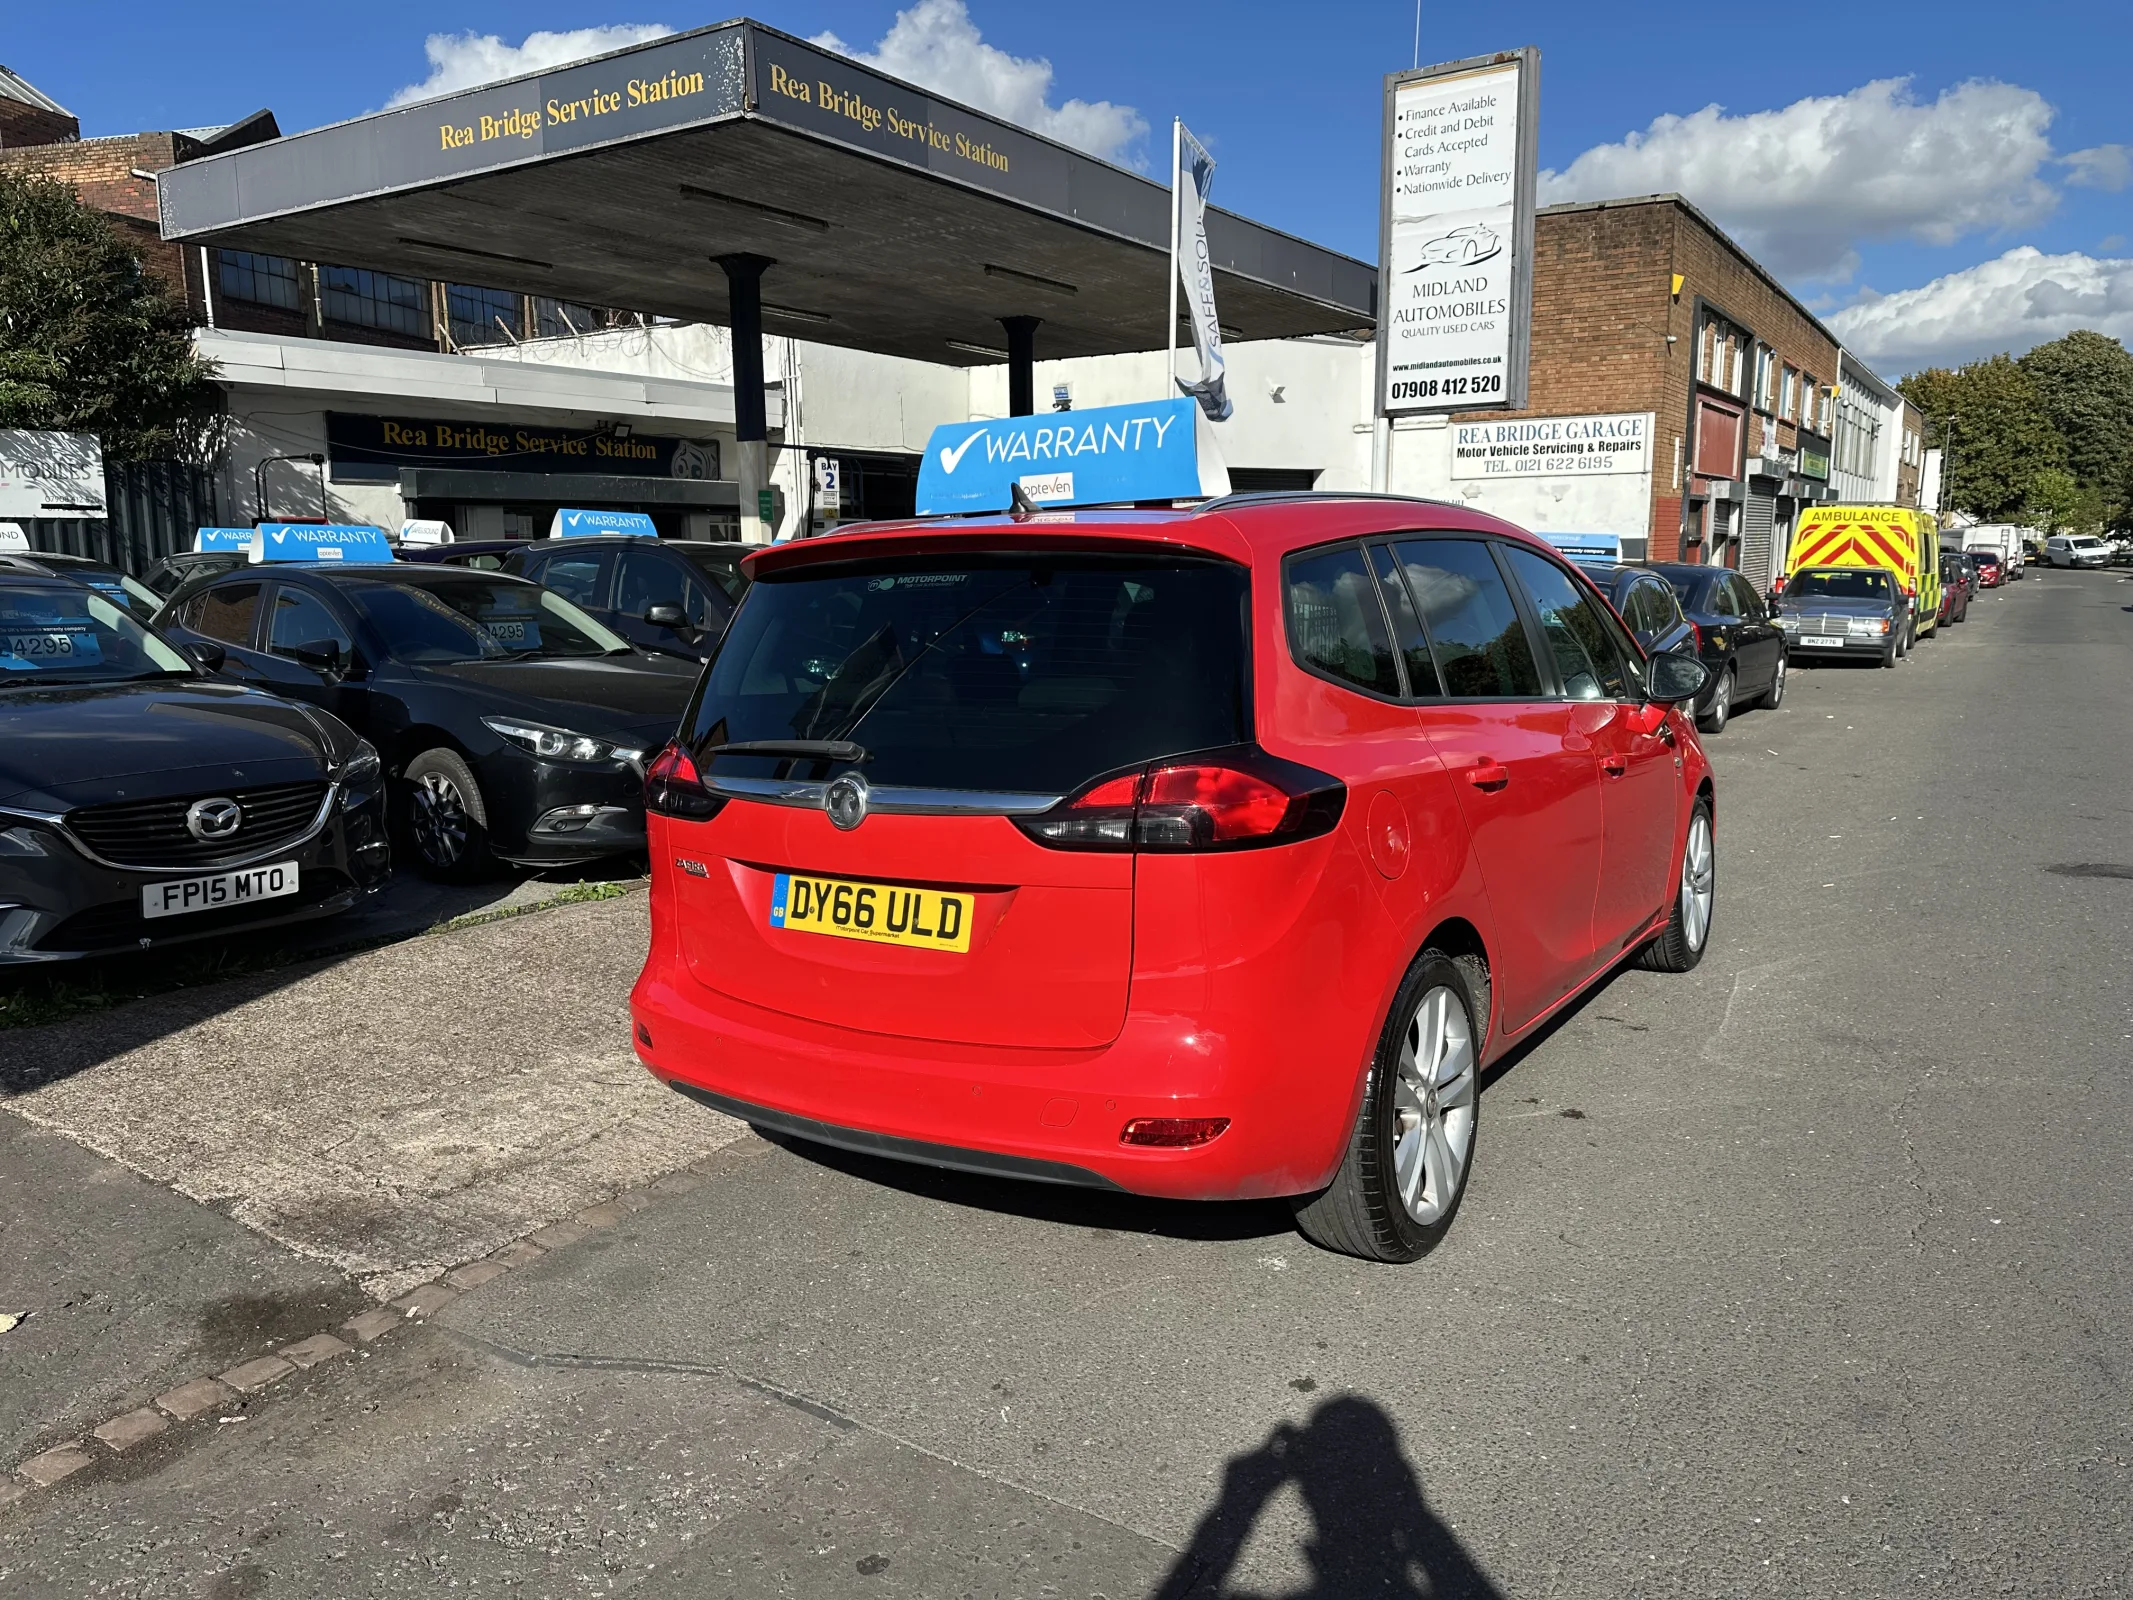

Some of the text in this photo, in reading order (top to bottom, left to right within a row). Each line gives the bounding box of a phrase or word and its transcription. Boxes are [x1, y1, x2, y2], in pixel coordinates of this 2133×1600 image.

[440, 69, 704, 150] Rea Bridge Service Station
[769, 62, 1009, 172] Rea Bridge Service Station
[1405, 95, 1497, 121] Finance Available
[1405, 115, 1494, 140] Credit and Debit
[1404, 133, 1488, 158] Cards Accepted
[1404, 161, 1452, 177] Warranty
[1404, 170, 1512, 195] Nationwide Delivery
[1412, 277, 1488, 298] MIDLAND
[1393, 298, 1506, 323] AUTOMOBILES
[1401, 320, 1495, 339] QUALITY USED CARS
[1392, 355, 1502, 372] www.midlandautomobiles.co.uk
[1391, 374, 1501, 399] 07908 412 520
[382, 421, 657, 459] Rea Bridge Service Station
[986, 414, 1177, 464] WARRANTY
[1458, 419, 1642, 444] REA BRIDGE GARAGE
[1456, 440, 1642, 458] Motor Vehicle Servicing & Repairs
[821, 462, 838, 471] BAY
[1484, 456, 1613, 473] TEL. 0121 622 6195
[825, 472, 835, 489] 2
[583, 514, 647, 529] WARRANTY
[1811, 511, 1901, 522] AMBULANCE
[292, 530, 377, 544] WARRANTY
[897, 574, 968, 584] MOTORPOINT
[491, 625, 523, 639] 4295
[14, 638, 71, 655] 4295
[162, 868, 284, 910] FP15 MTO
[773, 906, 785, 918] GB
[791, 879, 963, 940] DY66 ULD
